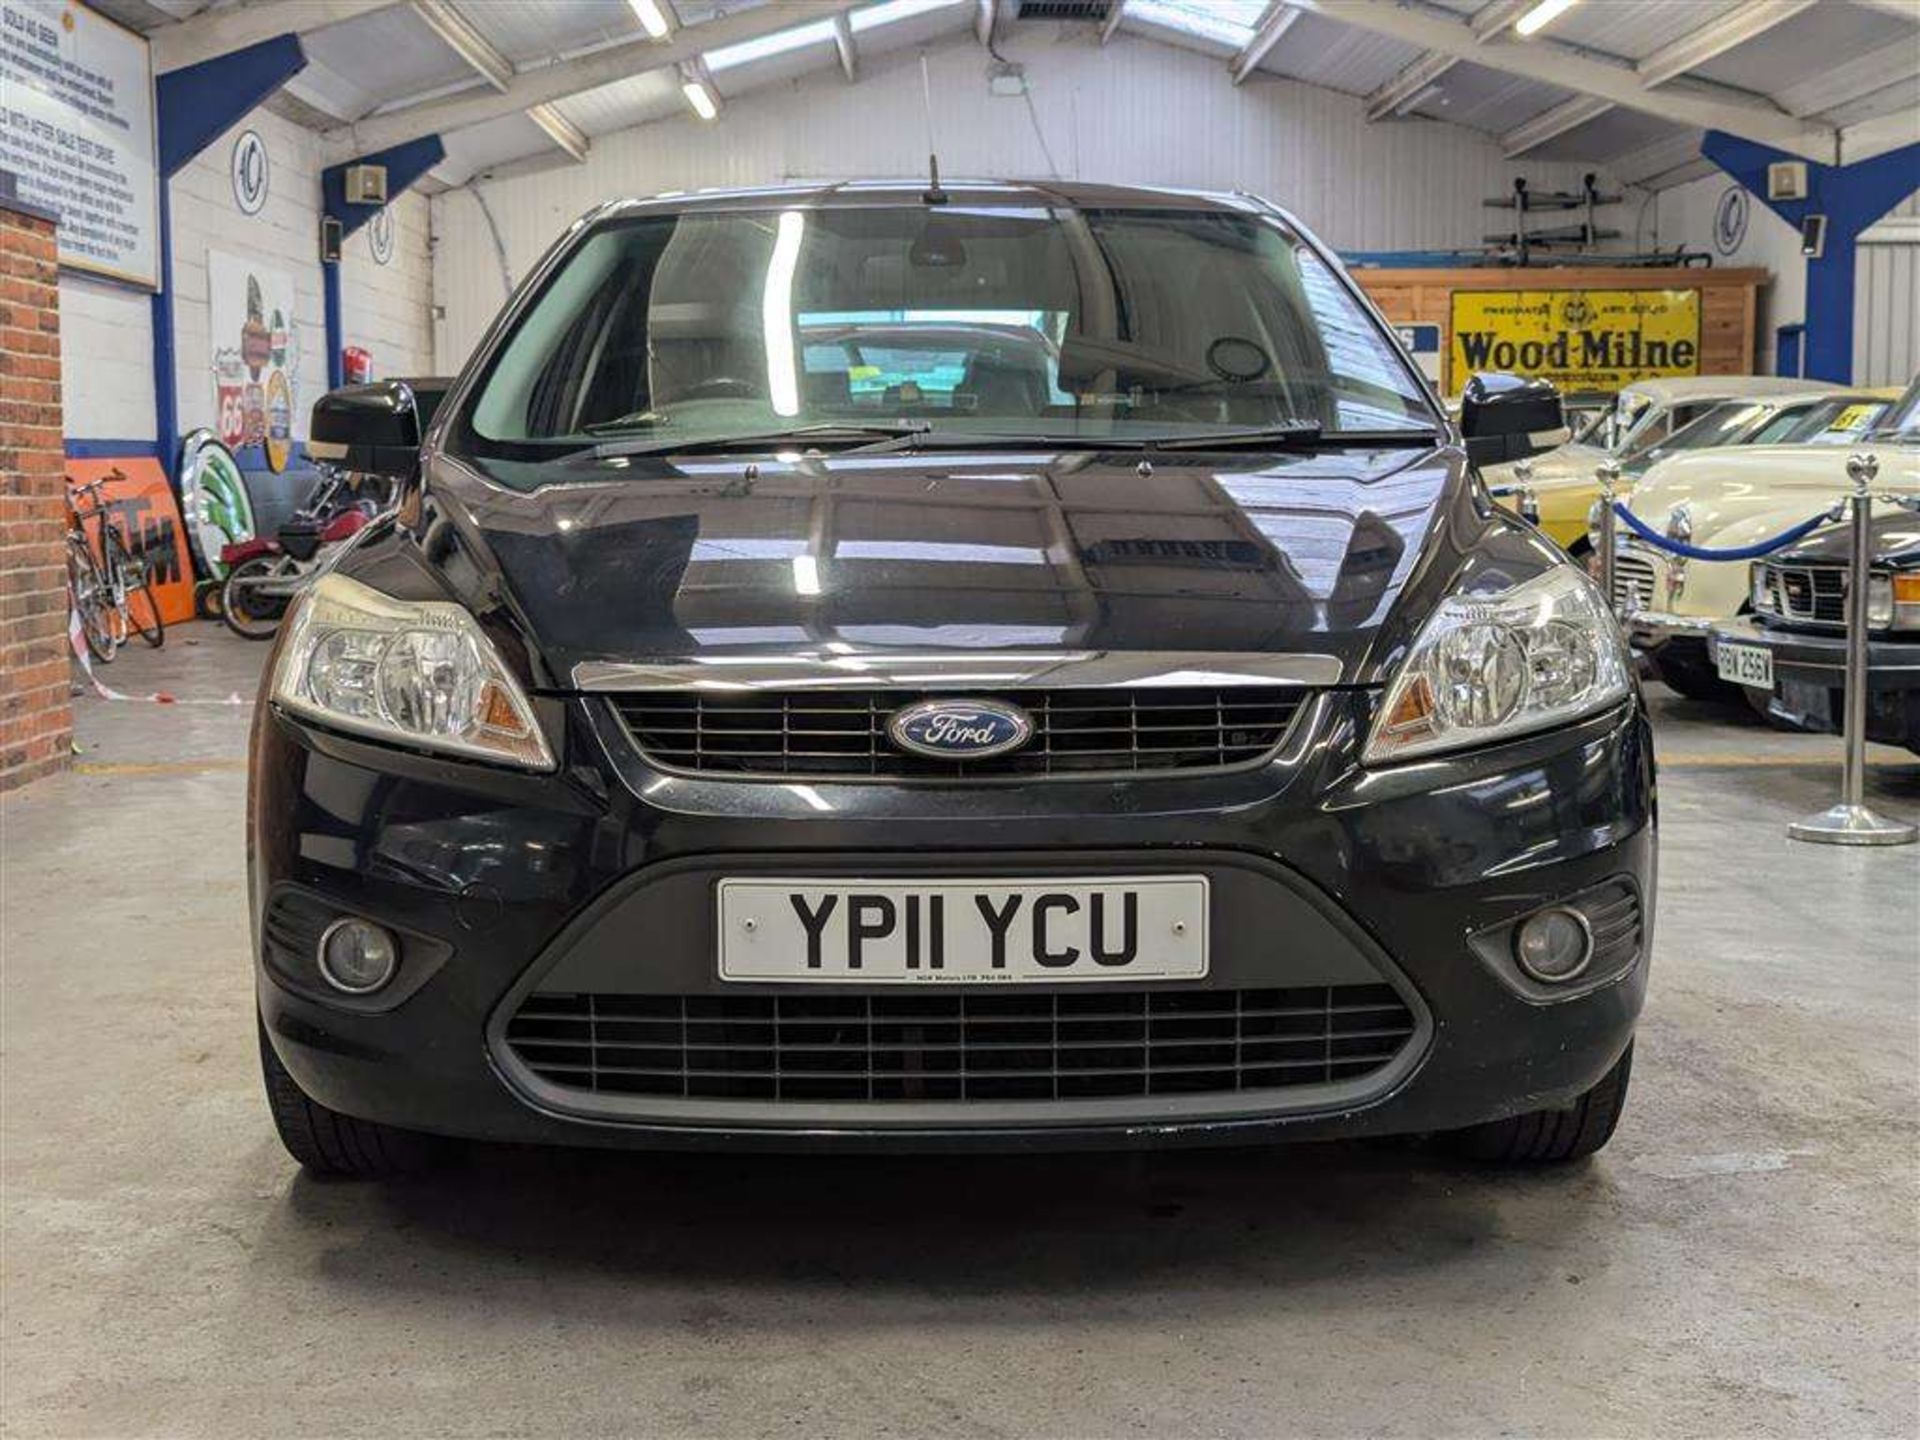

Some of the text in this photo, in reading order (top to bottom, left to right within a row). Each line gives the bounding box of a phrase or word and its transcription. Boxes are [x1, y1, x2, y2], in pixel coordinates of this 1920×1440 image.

[3, 6, 58, 46] SOLD AS SEEN
[31, 118, 55, 141] AFTER
[55, 128, 75, 150] SALE
[76, 135, 94, 156] TEST
[923, 713, 997, 744] Ford
[789, 892, 1138, 969] YP11 YCU
